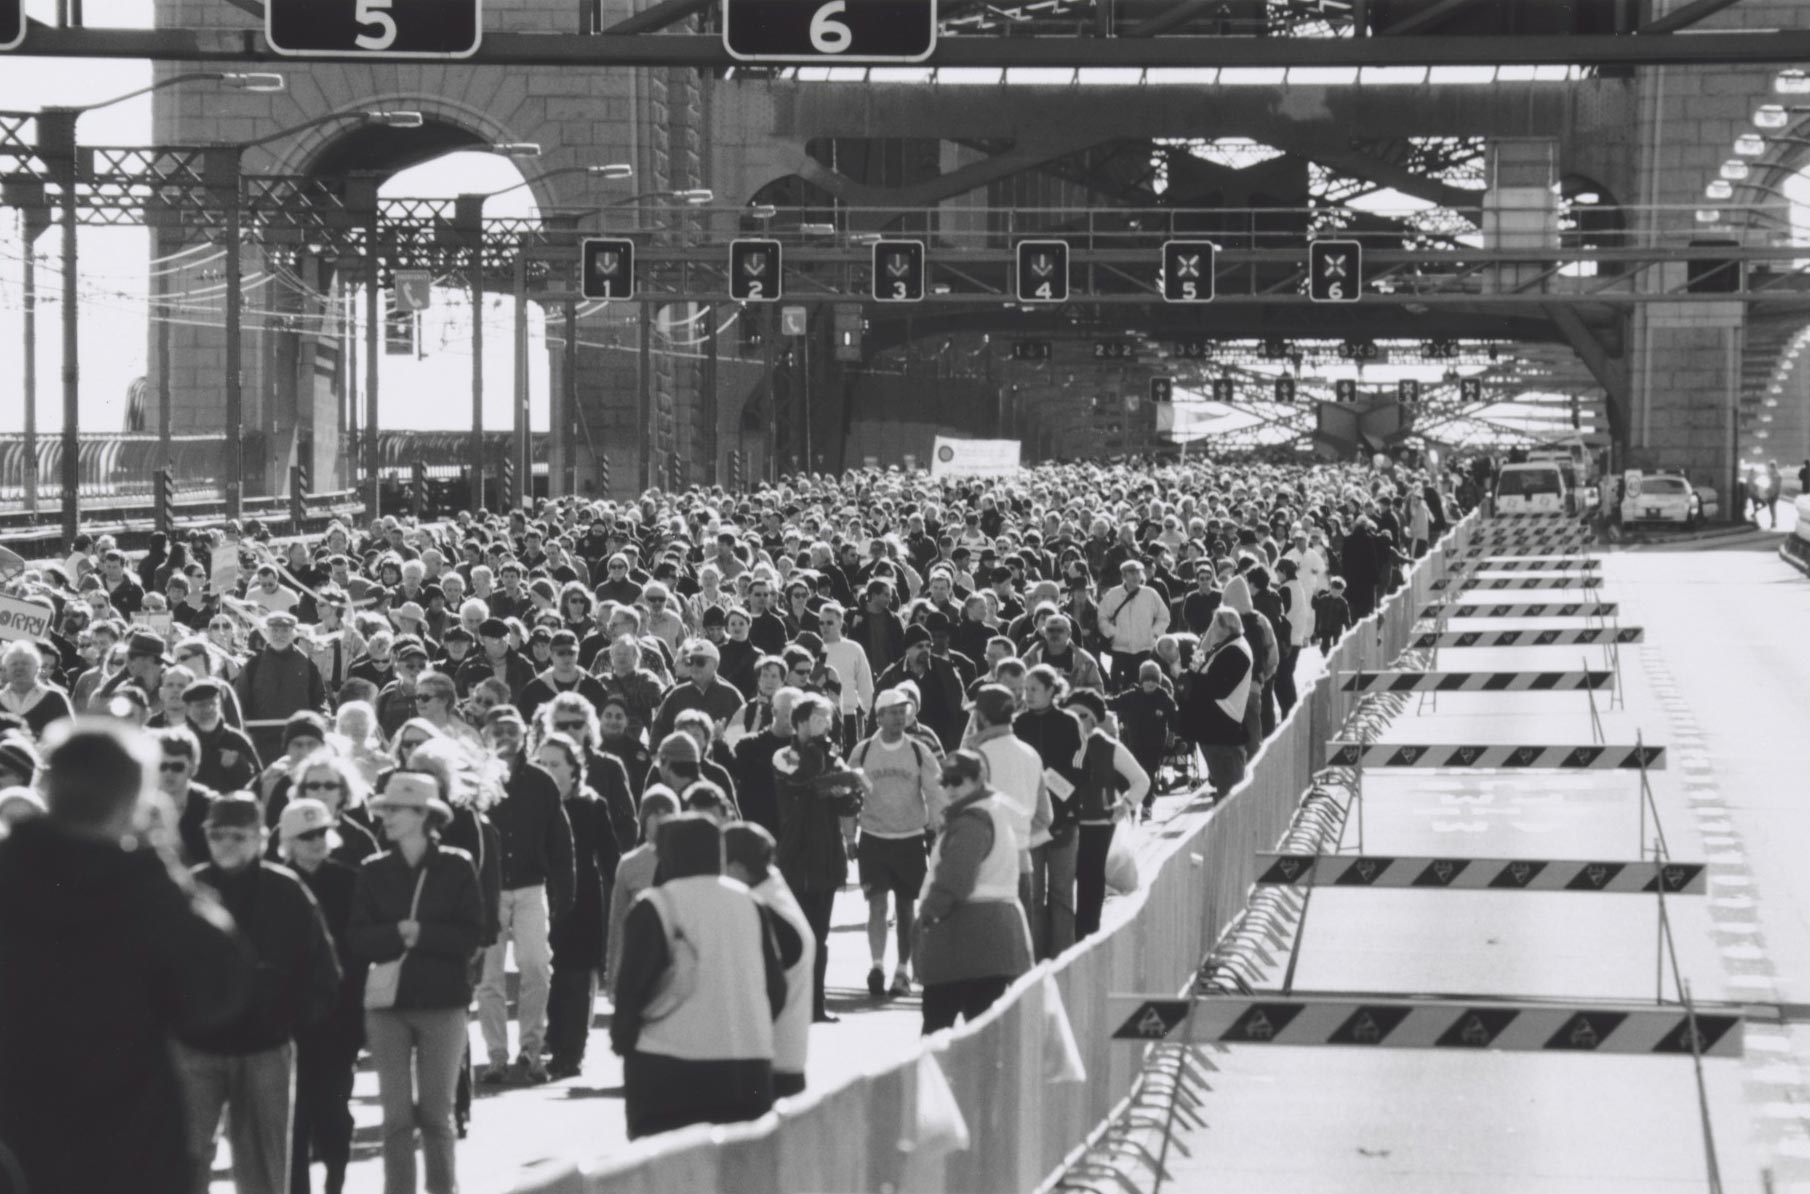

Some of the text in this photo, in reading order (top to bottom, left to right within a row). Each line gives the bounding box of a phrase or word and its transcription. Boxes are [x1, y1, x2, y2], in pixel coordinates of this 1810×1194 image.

[355, 0, 397, 50] 5
[809, 0, 852, 54] 6
[602, 279, 610, 298] 1
[748, 281, 763, 299] 2
[893, 281, 907, 299] 3
[1035, 281, 1052, 300] 4
[1182, 281, 1197, 299] 5
[1328, 281, 1343, 299] 6
[1095, 344, 1131, 356] 2 2
